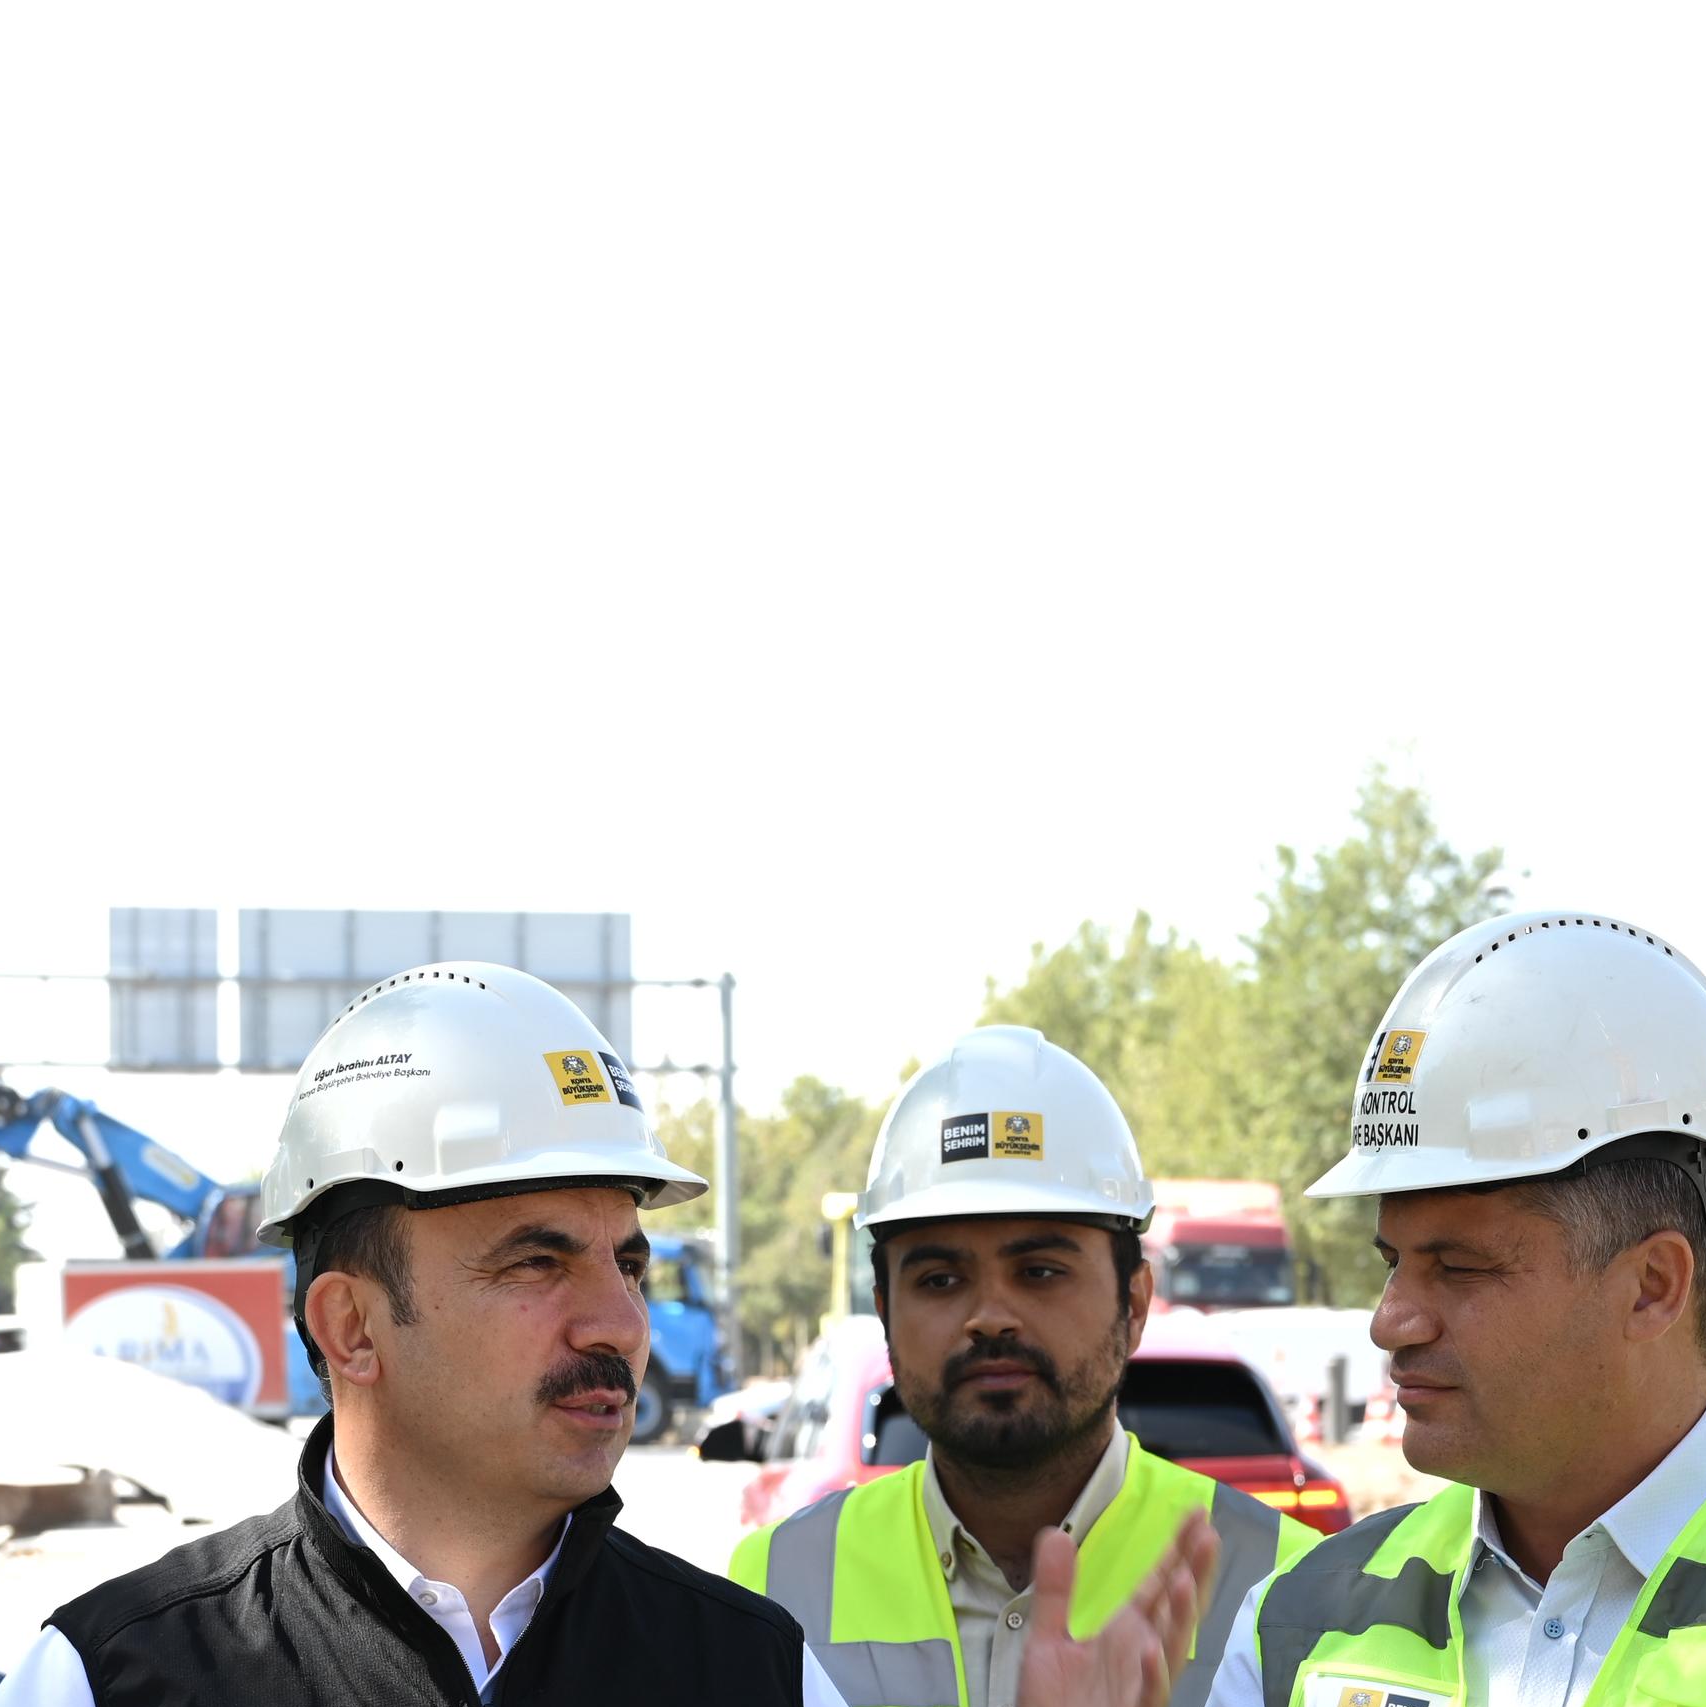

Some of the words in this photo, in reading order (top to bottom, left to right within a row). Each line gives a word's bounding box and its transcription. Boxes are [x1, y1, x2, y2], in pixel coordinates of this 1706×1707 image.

[314, 1068, 334, 1081] Uğur
[375, 1054, 412, 1065] ALTAY
[393, 1068, 431, 1078] Başkanı
[1361, 1091, 1416, 1115] KONTROL
[1364, 1123, 1419, 1153] BAŞKANI
